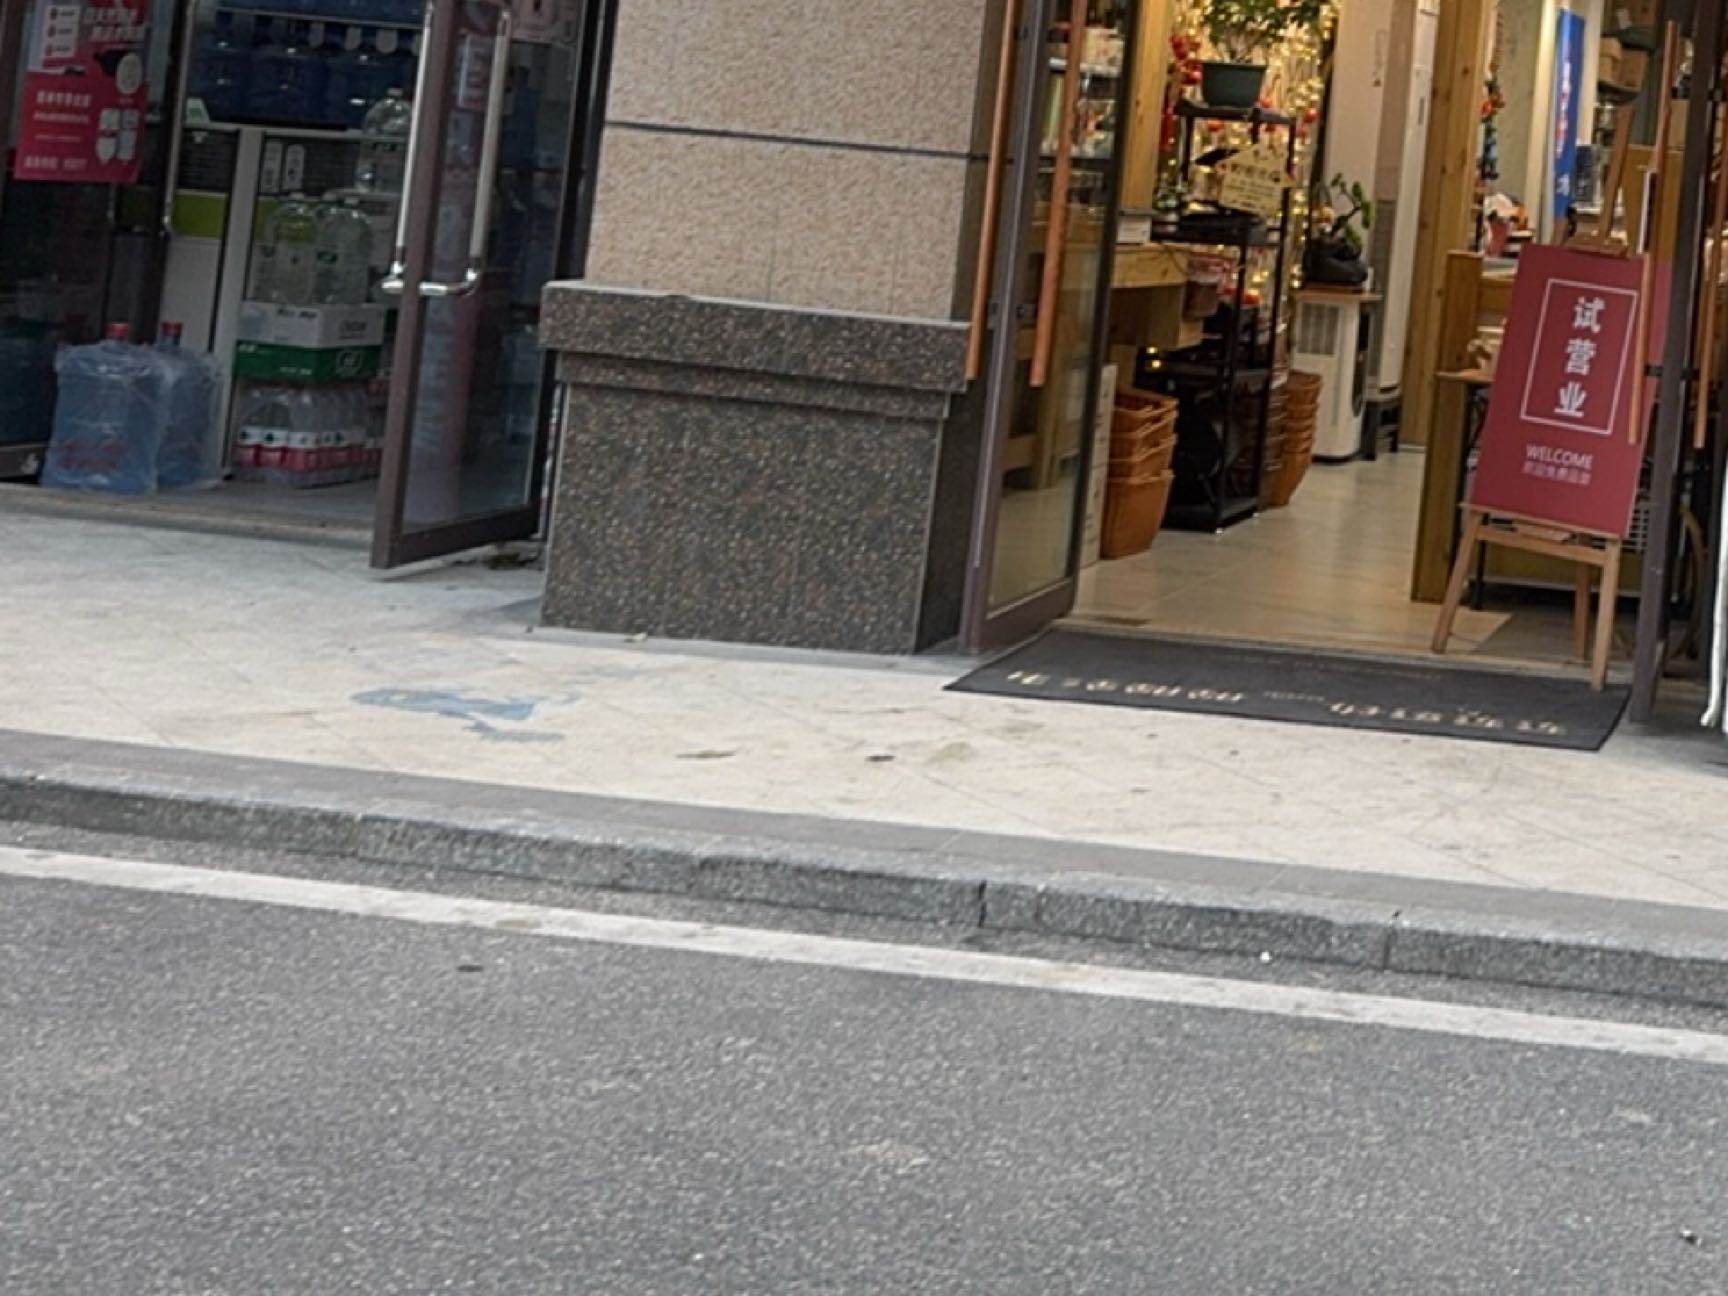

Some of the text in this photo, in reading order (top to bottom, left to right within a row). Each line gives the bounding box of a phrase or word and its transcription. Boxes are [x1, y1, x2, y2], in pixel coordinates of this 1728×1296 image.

[1554, 296, 1606, 418] 试营业
[1525, 444, 1594, 471] WELCOME
